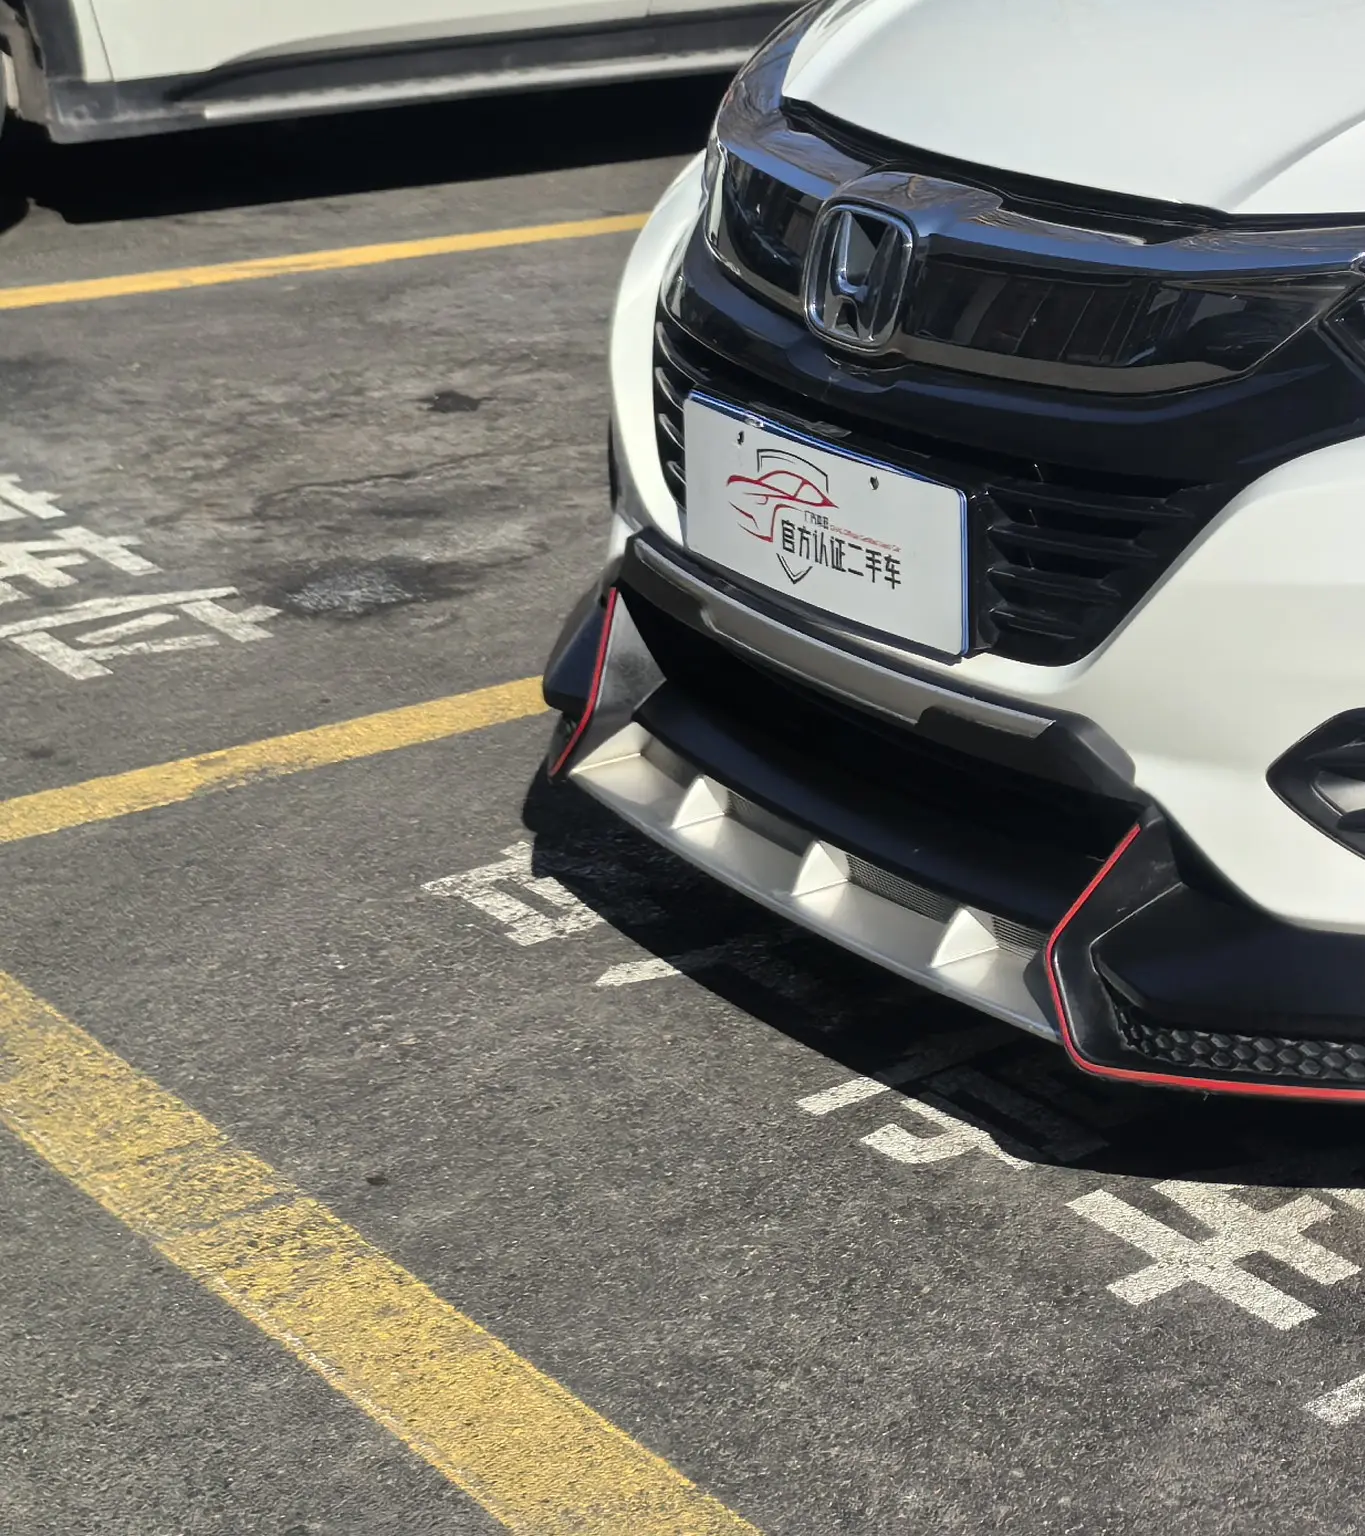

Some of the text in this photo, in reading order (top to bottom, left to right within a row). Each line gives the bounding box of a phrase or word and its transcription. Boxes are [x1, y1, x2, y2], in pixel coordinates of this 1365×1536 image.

[781, 519, 902, 590] 官方认证二手车
